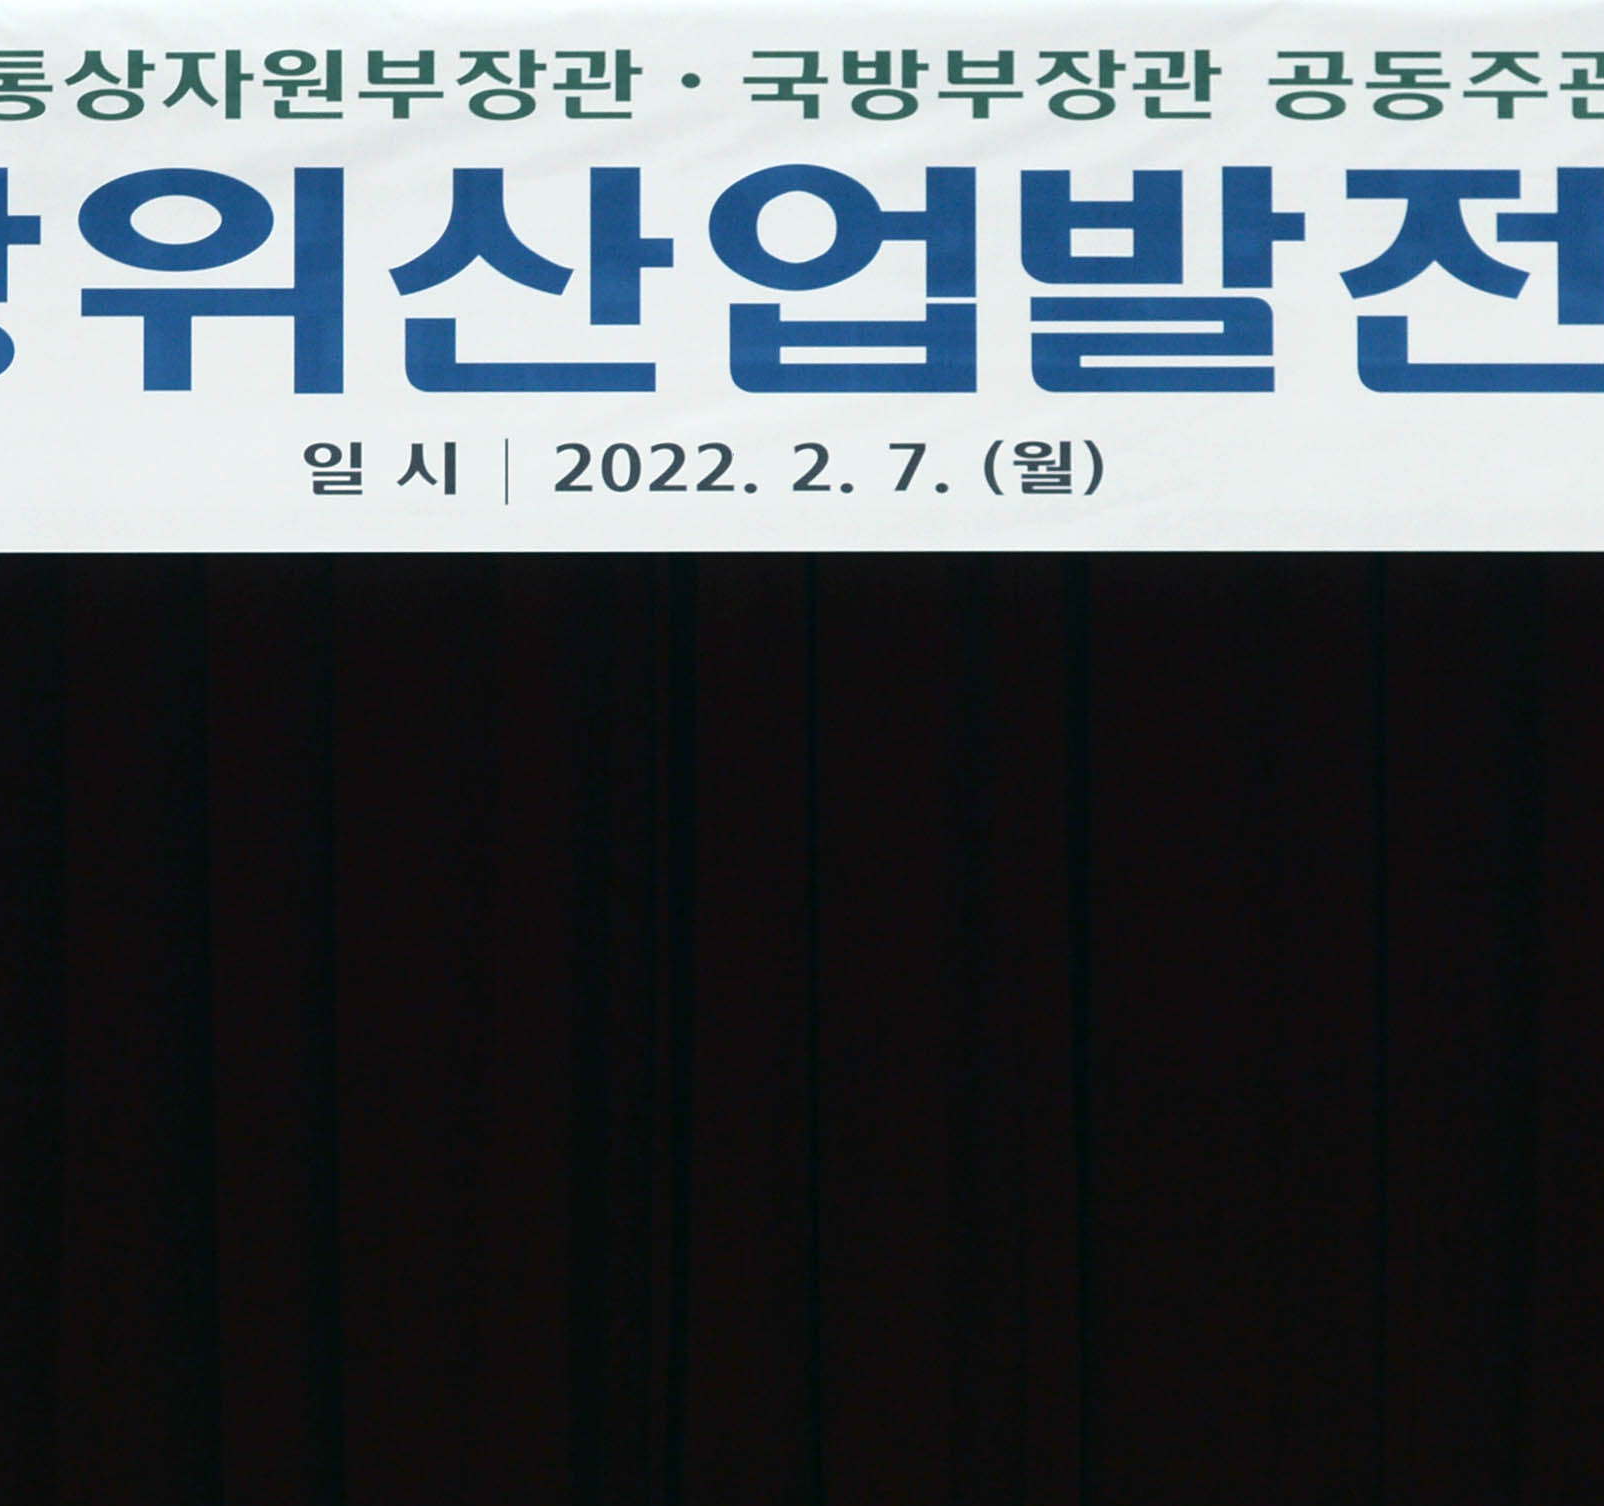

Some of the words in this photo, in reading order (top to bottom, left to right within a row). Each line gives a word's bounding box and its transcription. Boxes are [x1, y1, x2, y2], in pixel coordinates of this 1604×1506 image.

[742, 47, 1222, 121] 국방부장관
[554, 442, 758, 494] 2022.
[792, 442, 854, 494] 2.
[889, 442, 949, 494] 7.
[983, 439, 1104, 496] (월)
